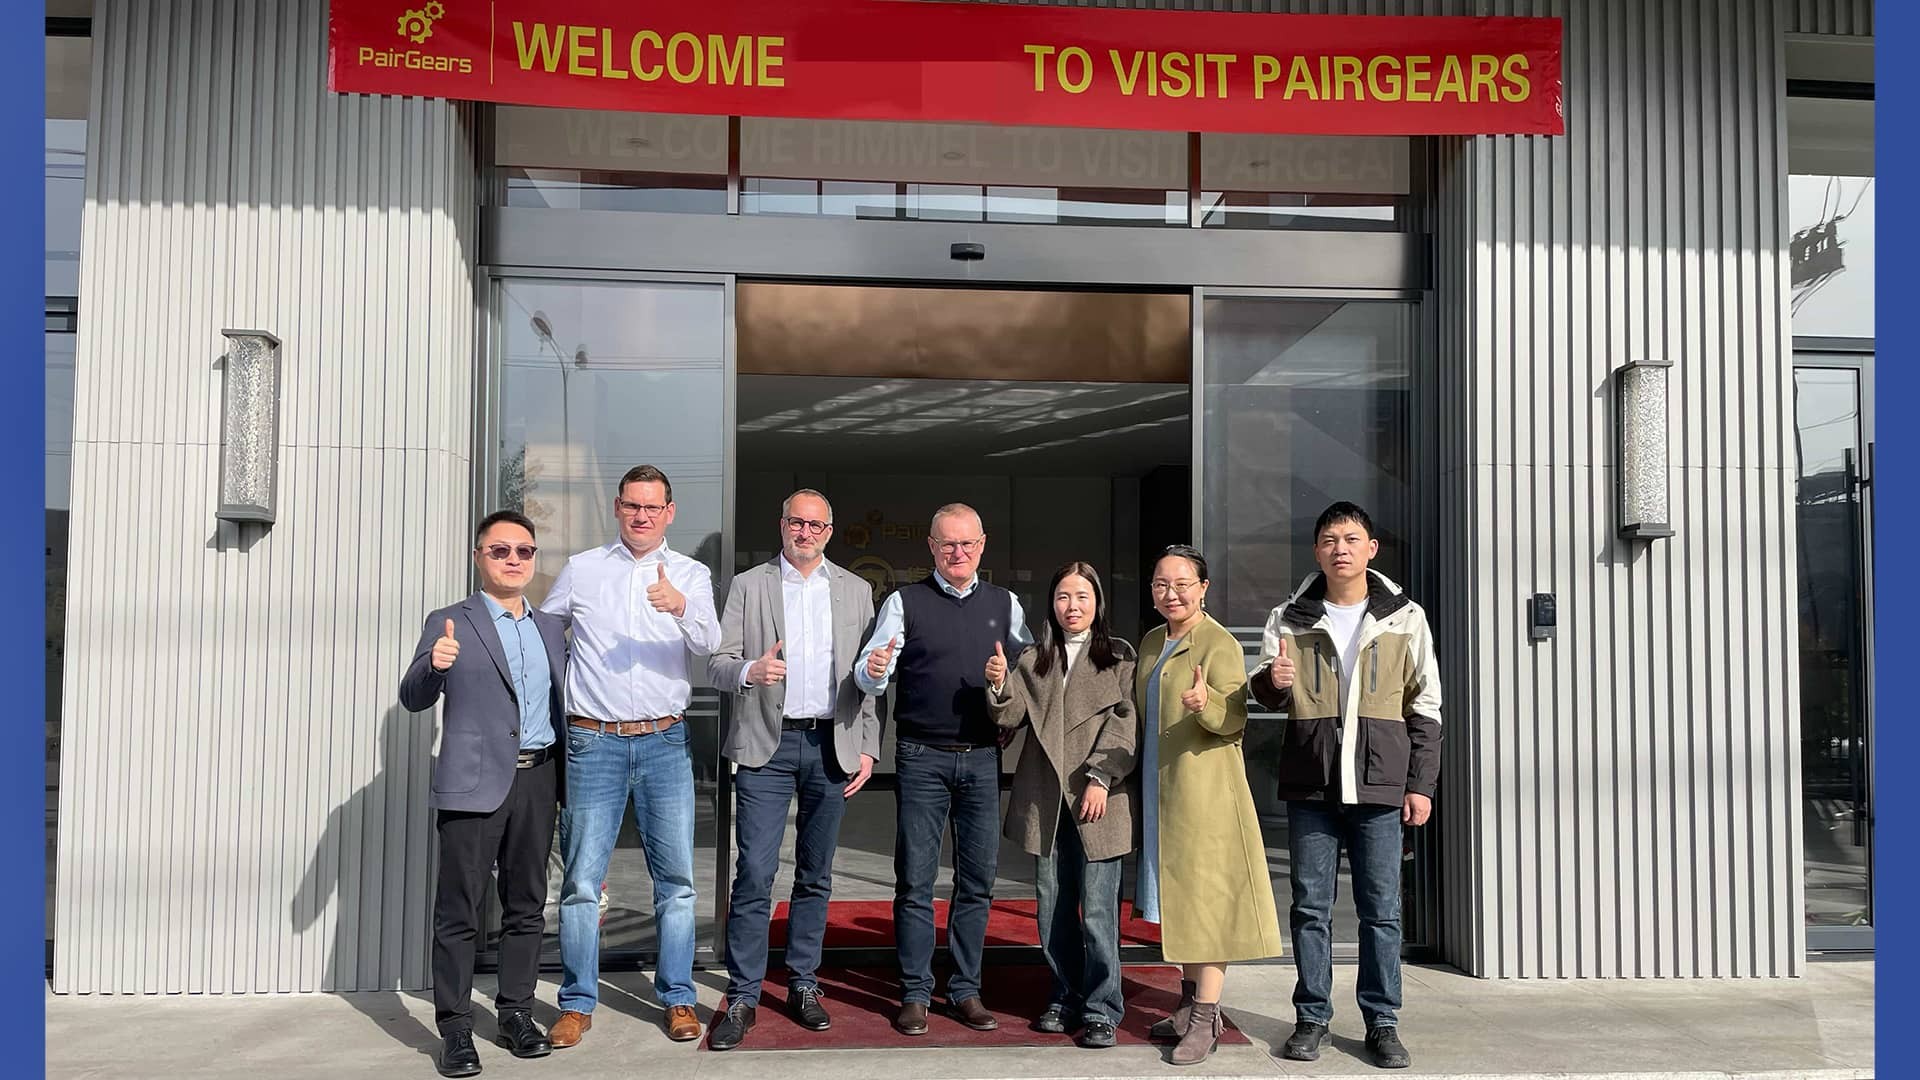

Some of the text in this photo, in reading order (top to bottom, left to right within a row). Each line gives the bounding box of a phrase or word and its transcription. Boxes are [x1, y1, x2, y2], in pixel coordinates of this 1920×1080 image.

[358, 46, 472, 73] PairGears
[512, 21, 1531, 103] WELCOME TO VISIT PAIRGEARS
[563, 111, 796, 165] WELCOME
[1003, 128, 1062, 174] TO
